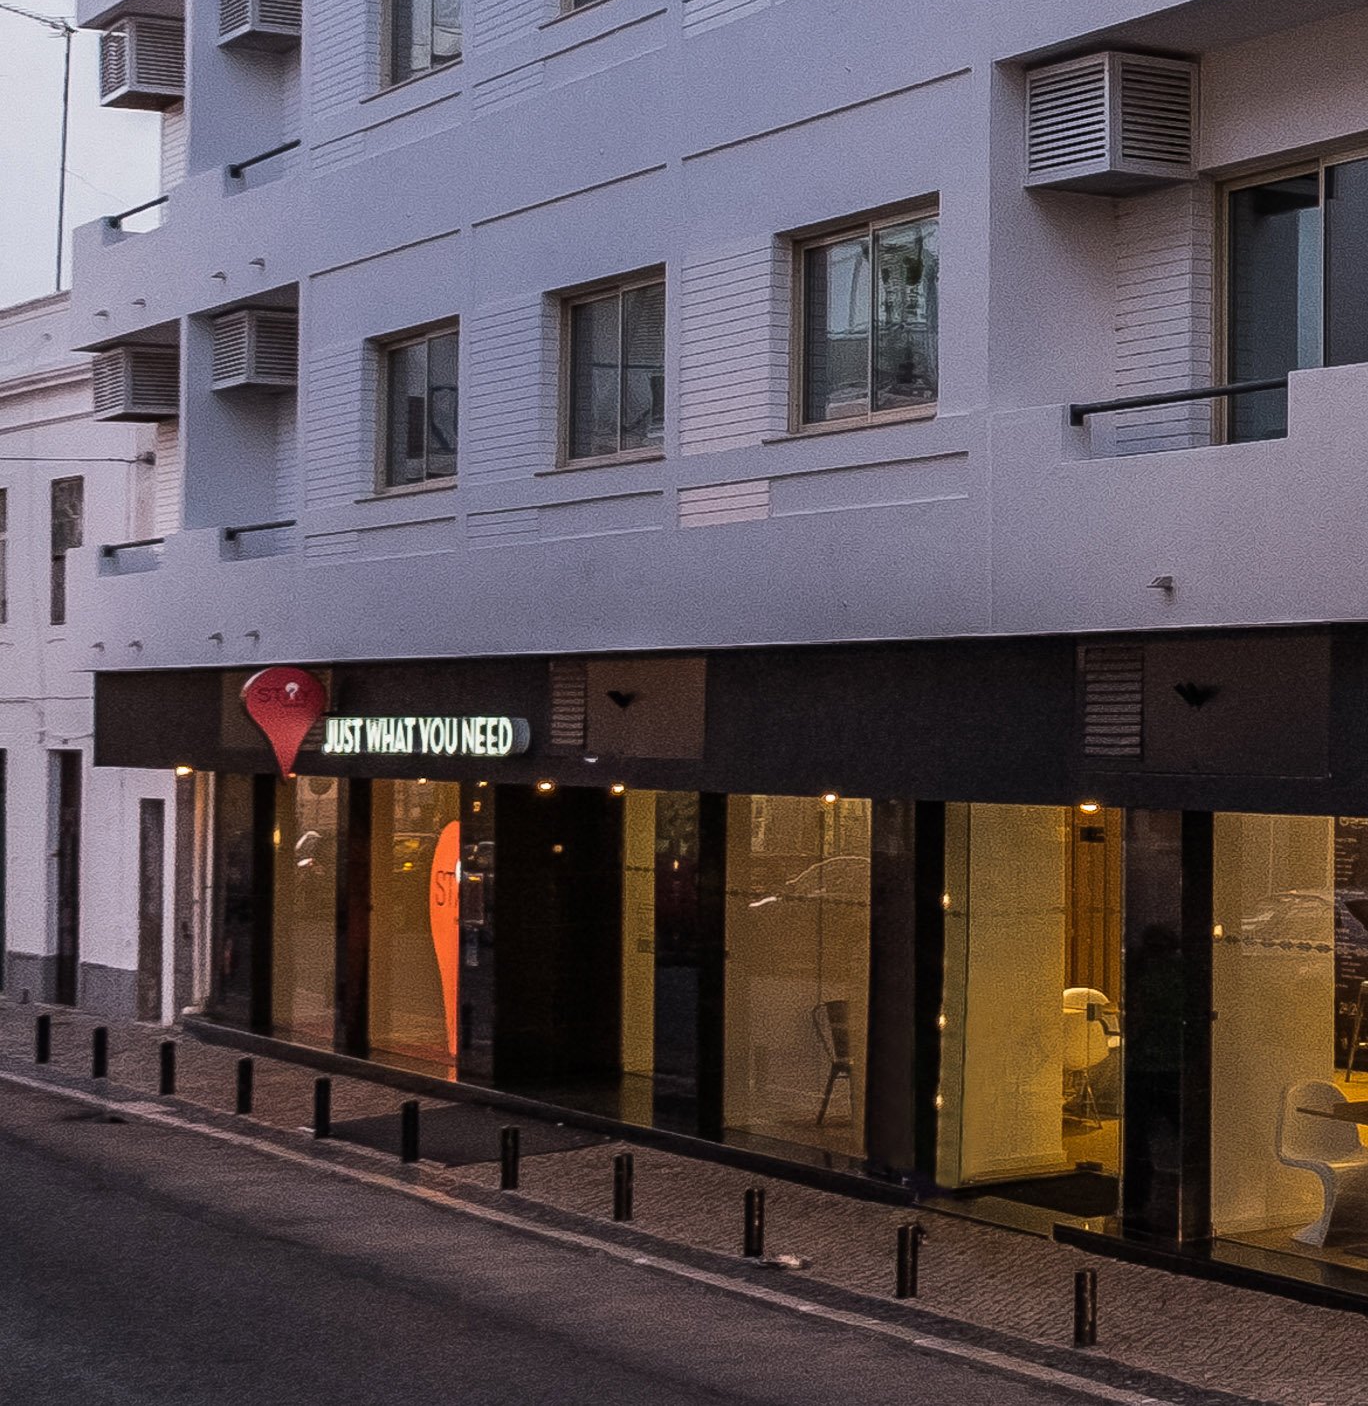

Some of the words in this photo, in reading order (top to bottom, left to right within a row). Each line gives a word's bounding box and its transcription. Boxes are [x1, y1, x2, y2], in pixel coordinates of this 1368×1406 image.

[323, 717, 364, 755] JUST
[366, 717, 416, 755] WHAT
[418, 717, 458, 756] YOU
[461, 716, 513, 756] NEED
[435, 870, 459, 907] ST
